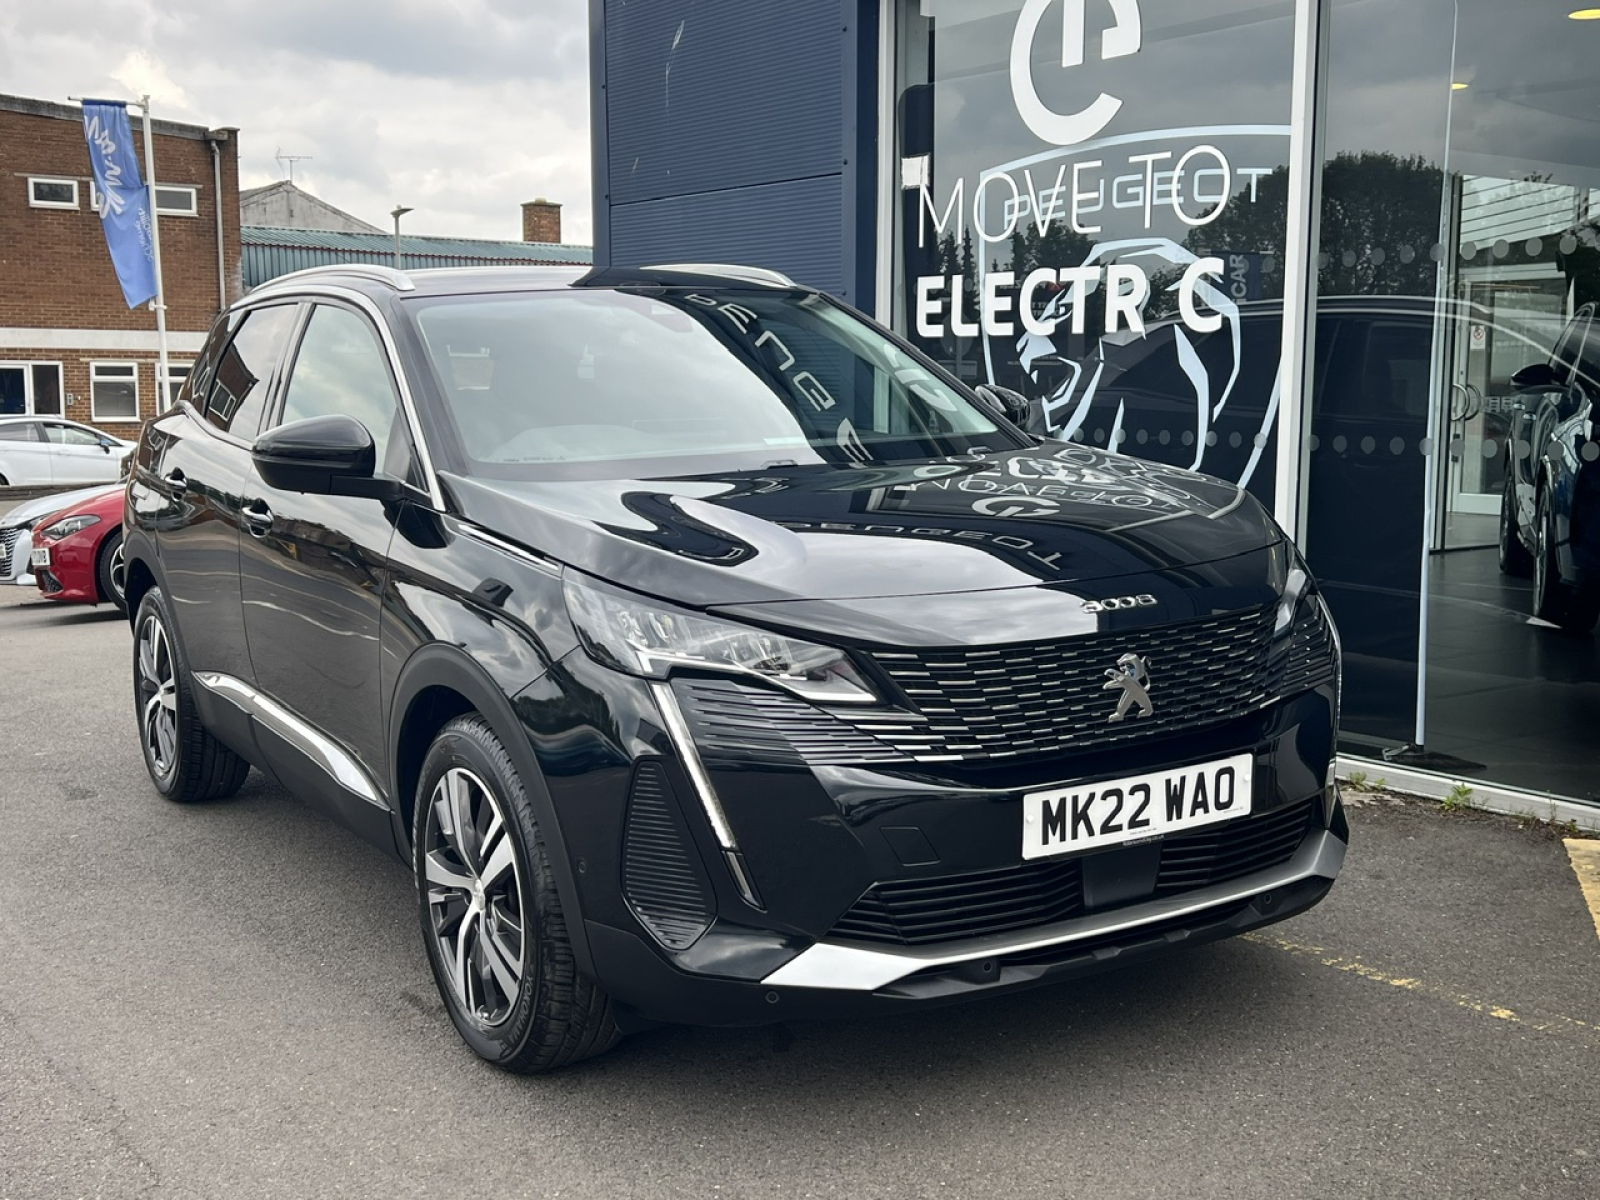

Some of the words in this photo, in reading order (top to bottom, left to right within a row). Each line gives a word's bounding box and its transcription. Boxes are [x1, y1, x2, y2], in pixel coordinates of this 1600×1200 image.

[918, 160, 1102, 248] MOVE
[1129, 144, 1230, 228] TO
[1004, 167, 1272, 230] PEUGEOT
[1080, 594, 1157, 614] 3008
[1041, 783, 1151, 846] MK22
[1165, 766, 1236, 822] WAO
